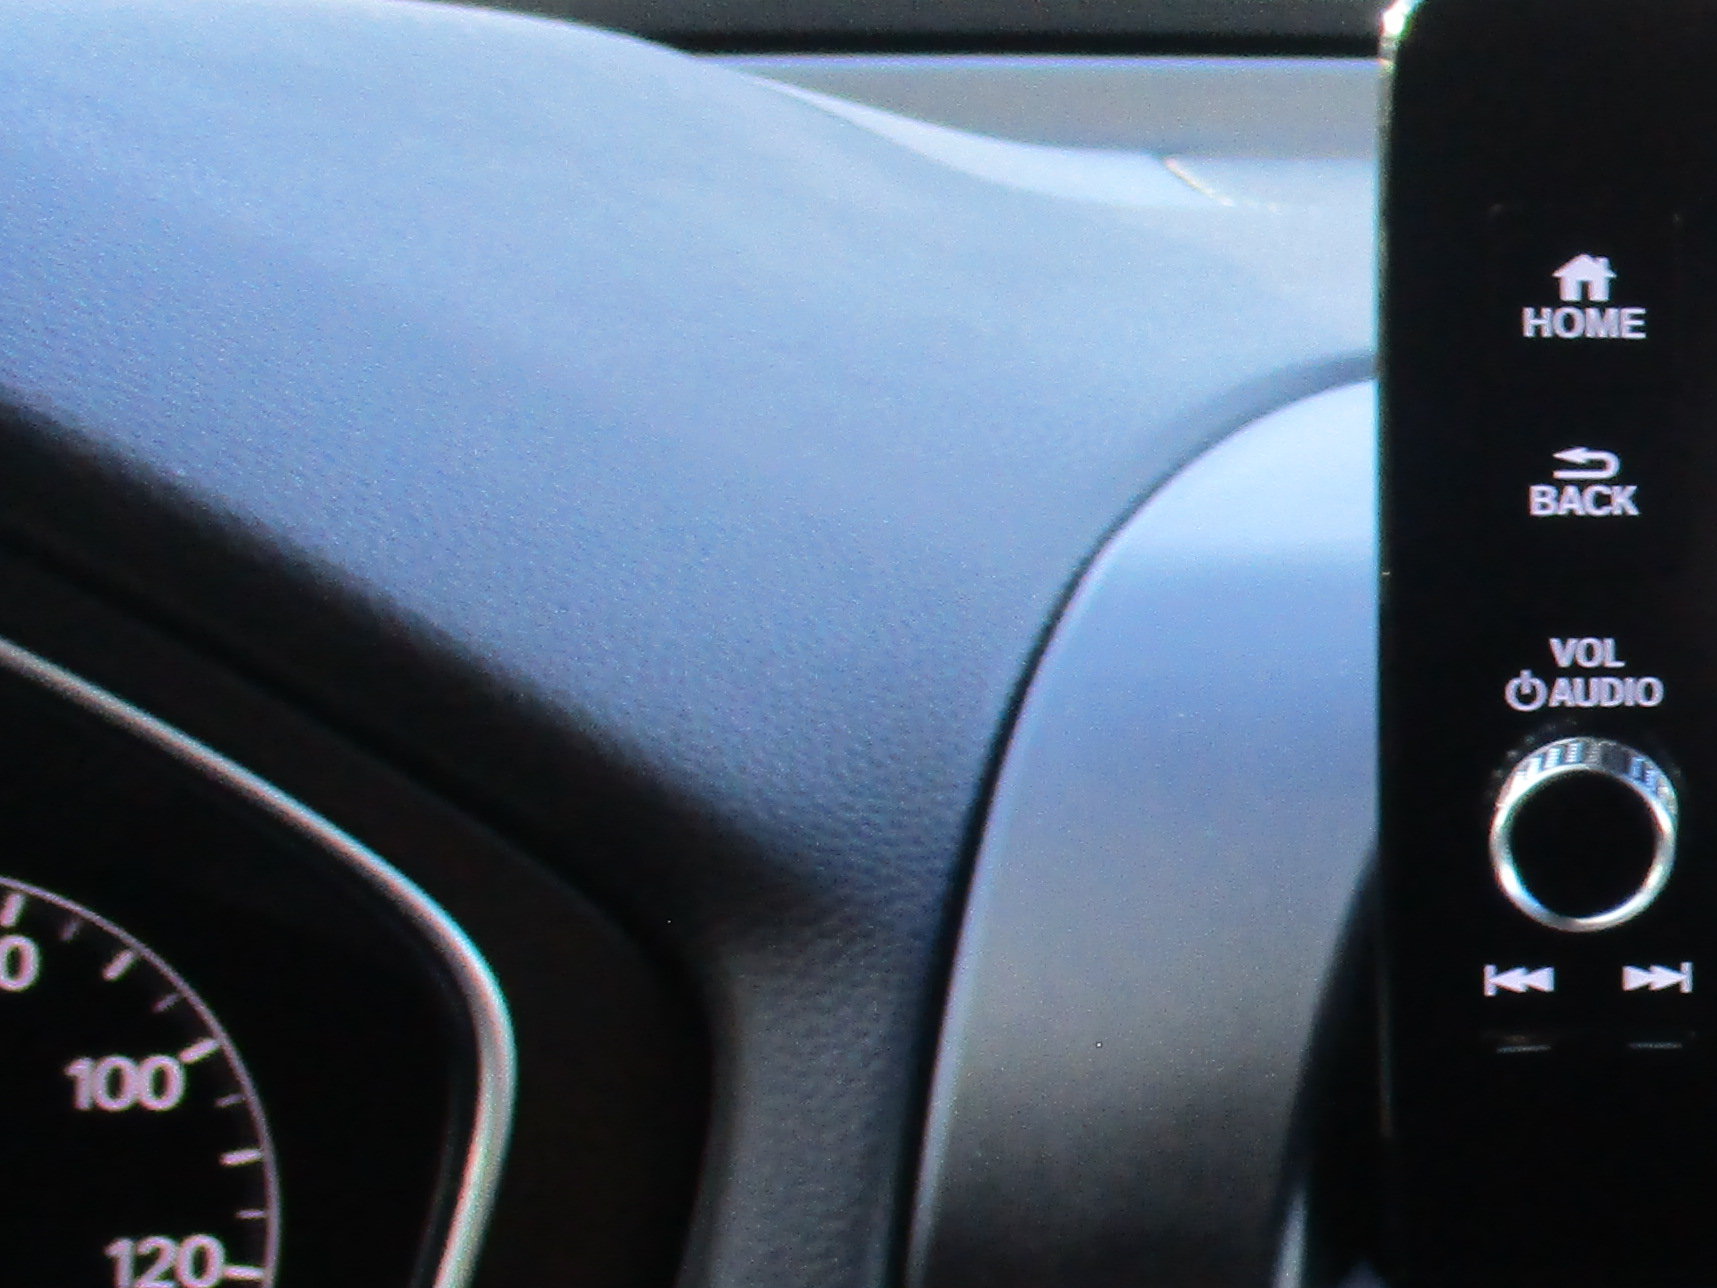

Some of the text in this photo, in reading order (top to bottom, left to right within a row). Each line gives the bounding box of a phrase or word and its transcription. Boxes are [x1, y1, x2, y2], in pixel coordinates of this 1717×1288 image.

[1522, 307, 1647, 339] HOME
[1529, 485, 1639, 516] BACK
[1549, 636, 1625, 668] VOL
[1548, 676, 1665, 708] AUDIO
[65, 1055, 186, 1112] 100
